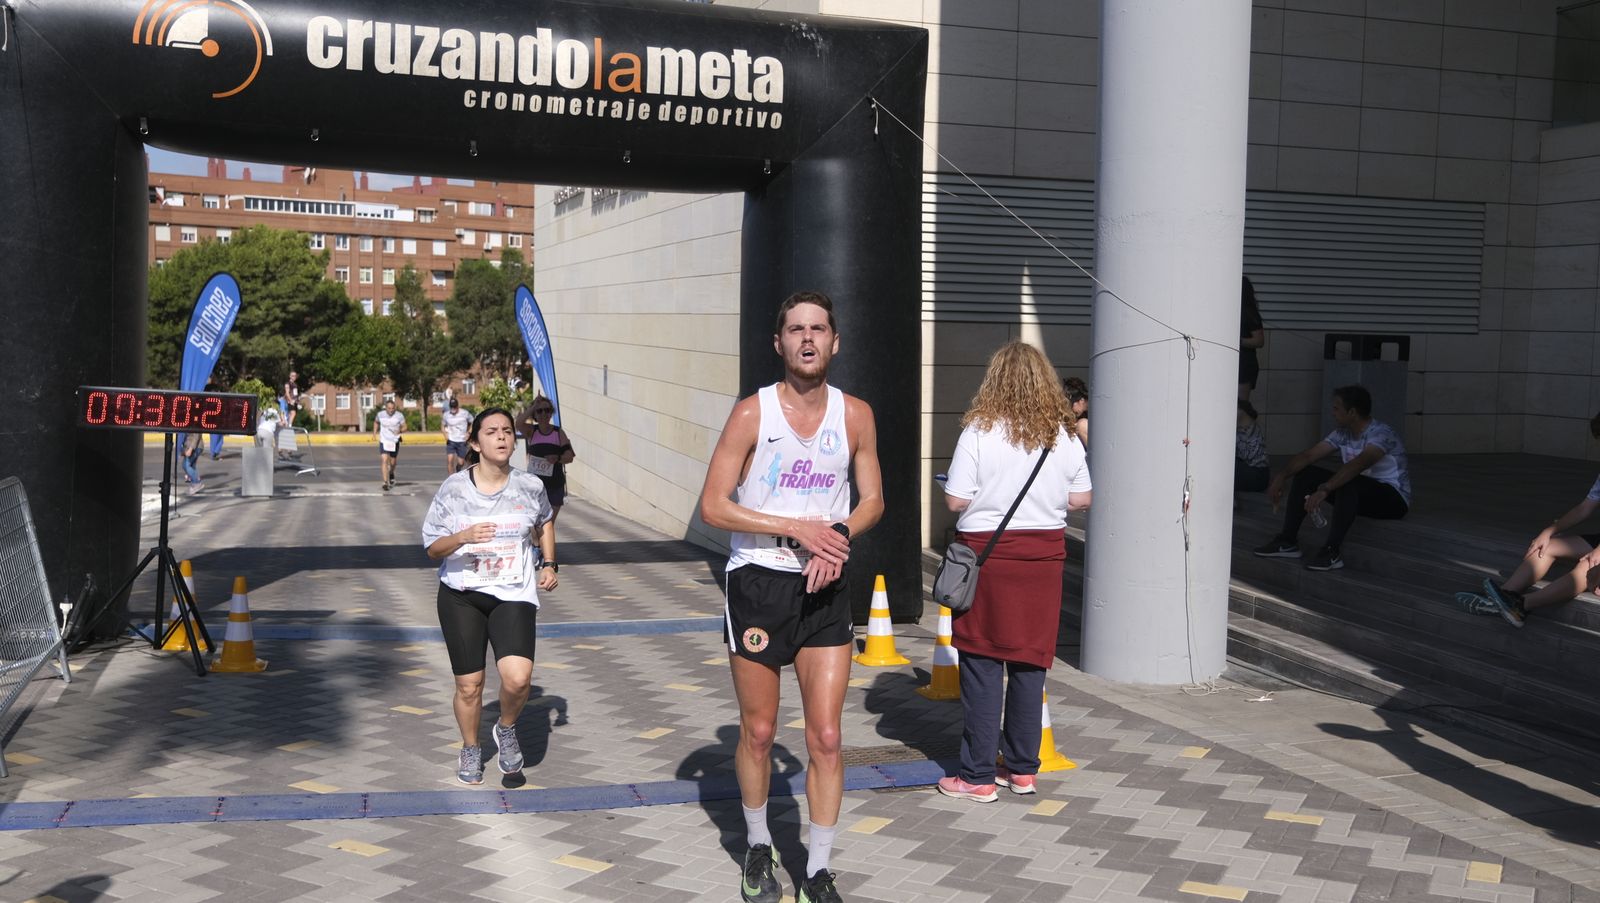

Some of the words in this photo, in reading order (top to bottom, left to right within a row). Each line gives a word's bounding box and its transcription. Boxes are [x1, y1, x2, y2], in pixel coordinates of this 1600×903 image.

[463, 89, 650, 121] cronometraje
[658, 100, 783, 129] deportivo
[791, 459, 814, 475] GO
[779, 473, 836, 489] TRAING
